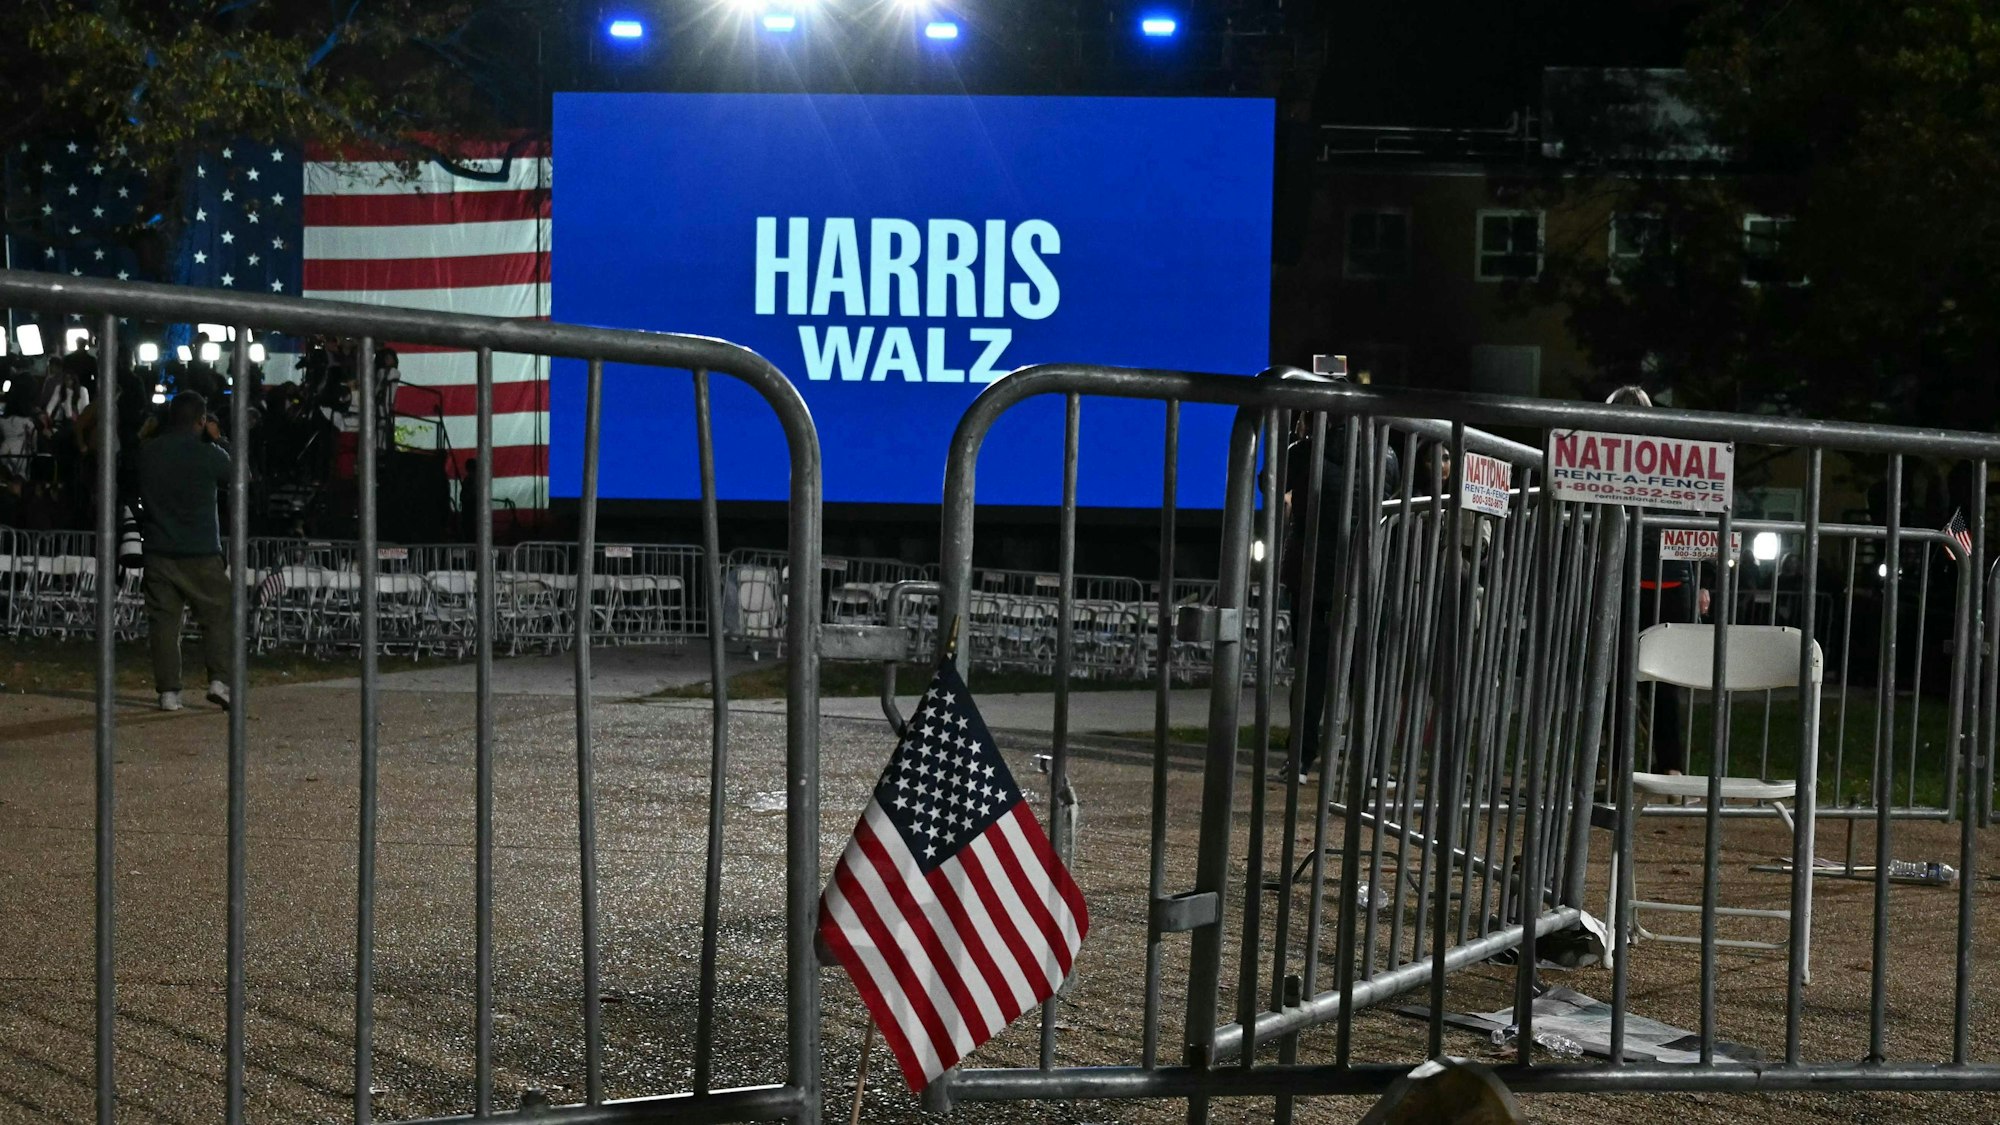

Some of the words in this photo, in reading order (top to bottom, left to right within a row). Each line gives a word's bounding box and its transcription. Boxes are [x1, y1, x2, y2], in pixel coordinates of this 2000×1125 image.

[755, 216, 1061, 320] HARRIS
[798, 325, 1012, 383] WALZ
[1554, 434, 1726, 481] NATIONAL
[1466, 454, 1509, 492] NATIONAL
[1554, 468, 1725, 491] RENT-A-FENCE
[1465, 483, 1509, 501] RENT-A-FENCE
[1553, 480, 1724, 503] 1-800-352-5675
[1664, 530, 1738, 548] NATIONL
